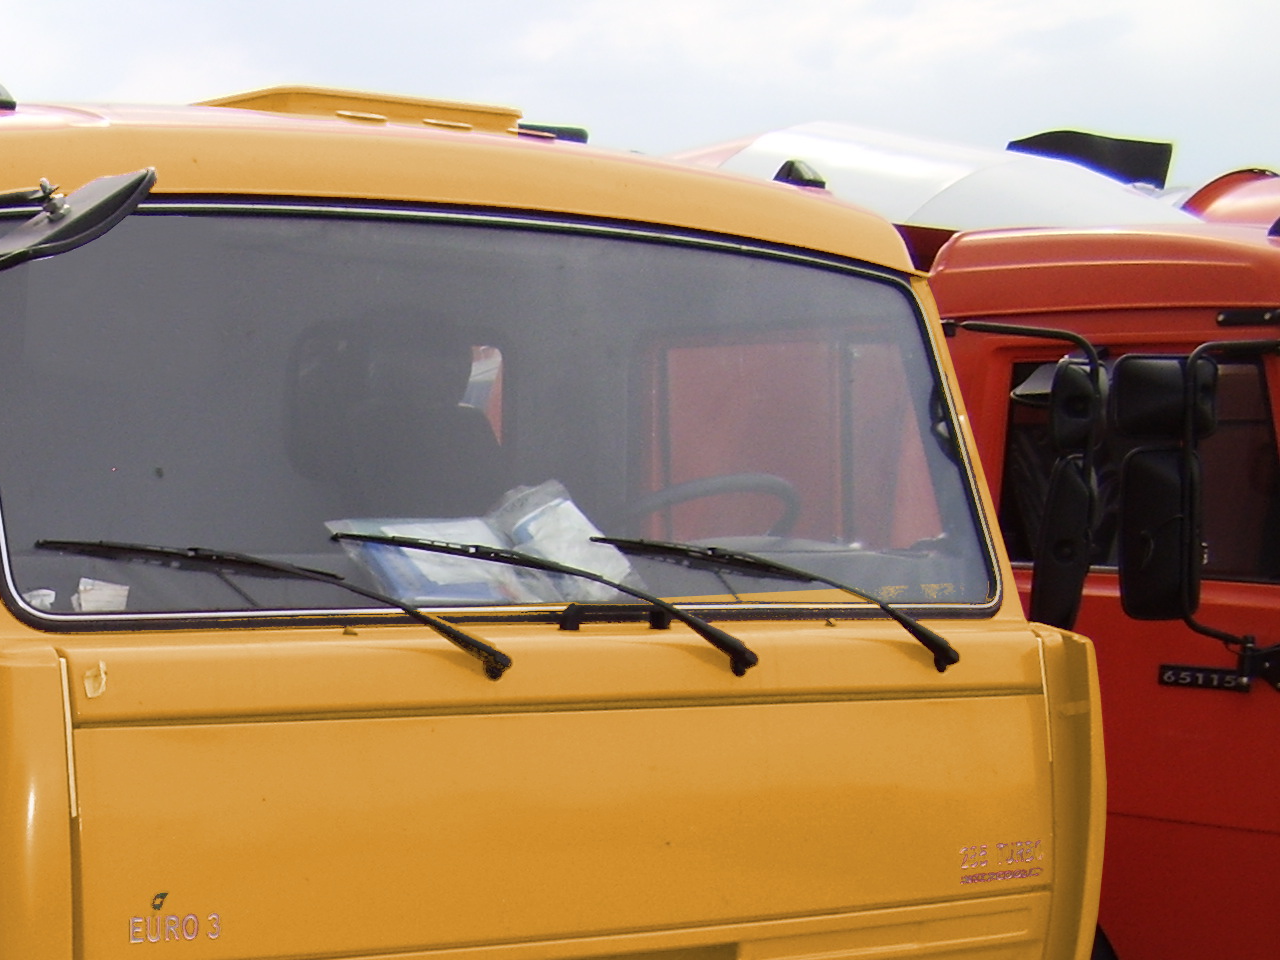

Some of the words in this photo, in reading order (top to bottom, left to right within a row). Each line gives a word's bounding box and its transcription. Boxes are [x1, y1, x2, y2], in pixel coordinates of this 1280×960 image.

[1163, 671, 1237, 687] 65115
[129, 914, 199, 944] EURO
[207, 913, 221, 939] 3
